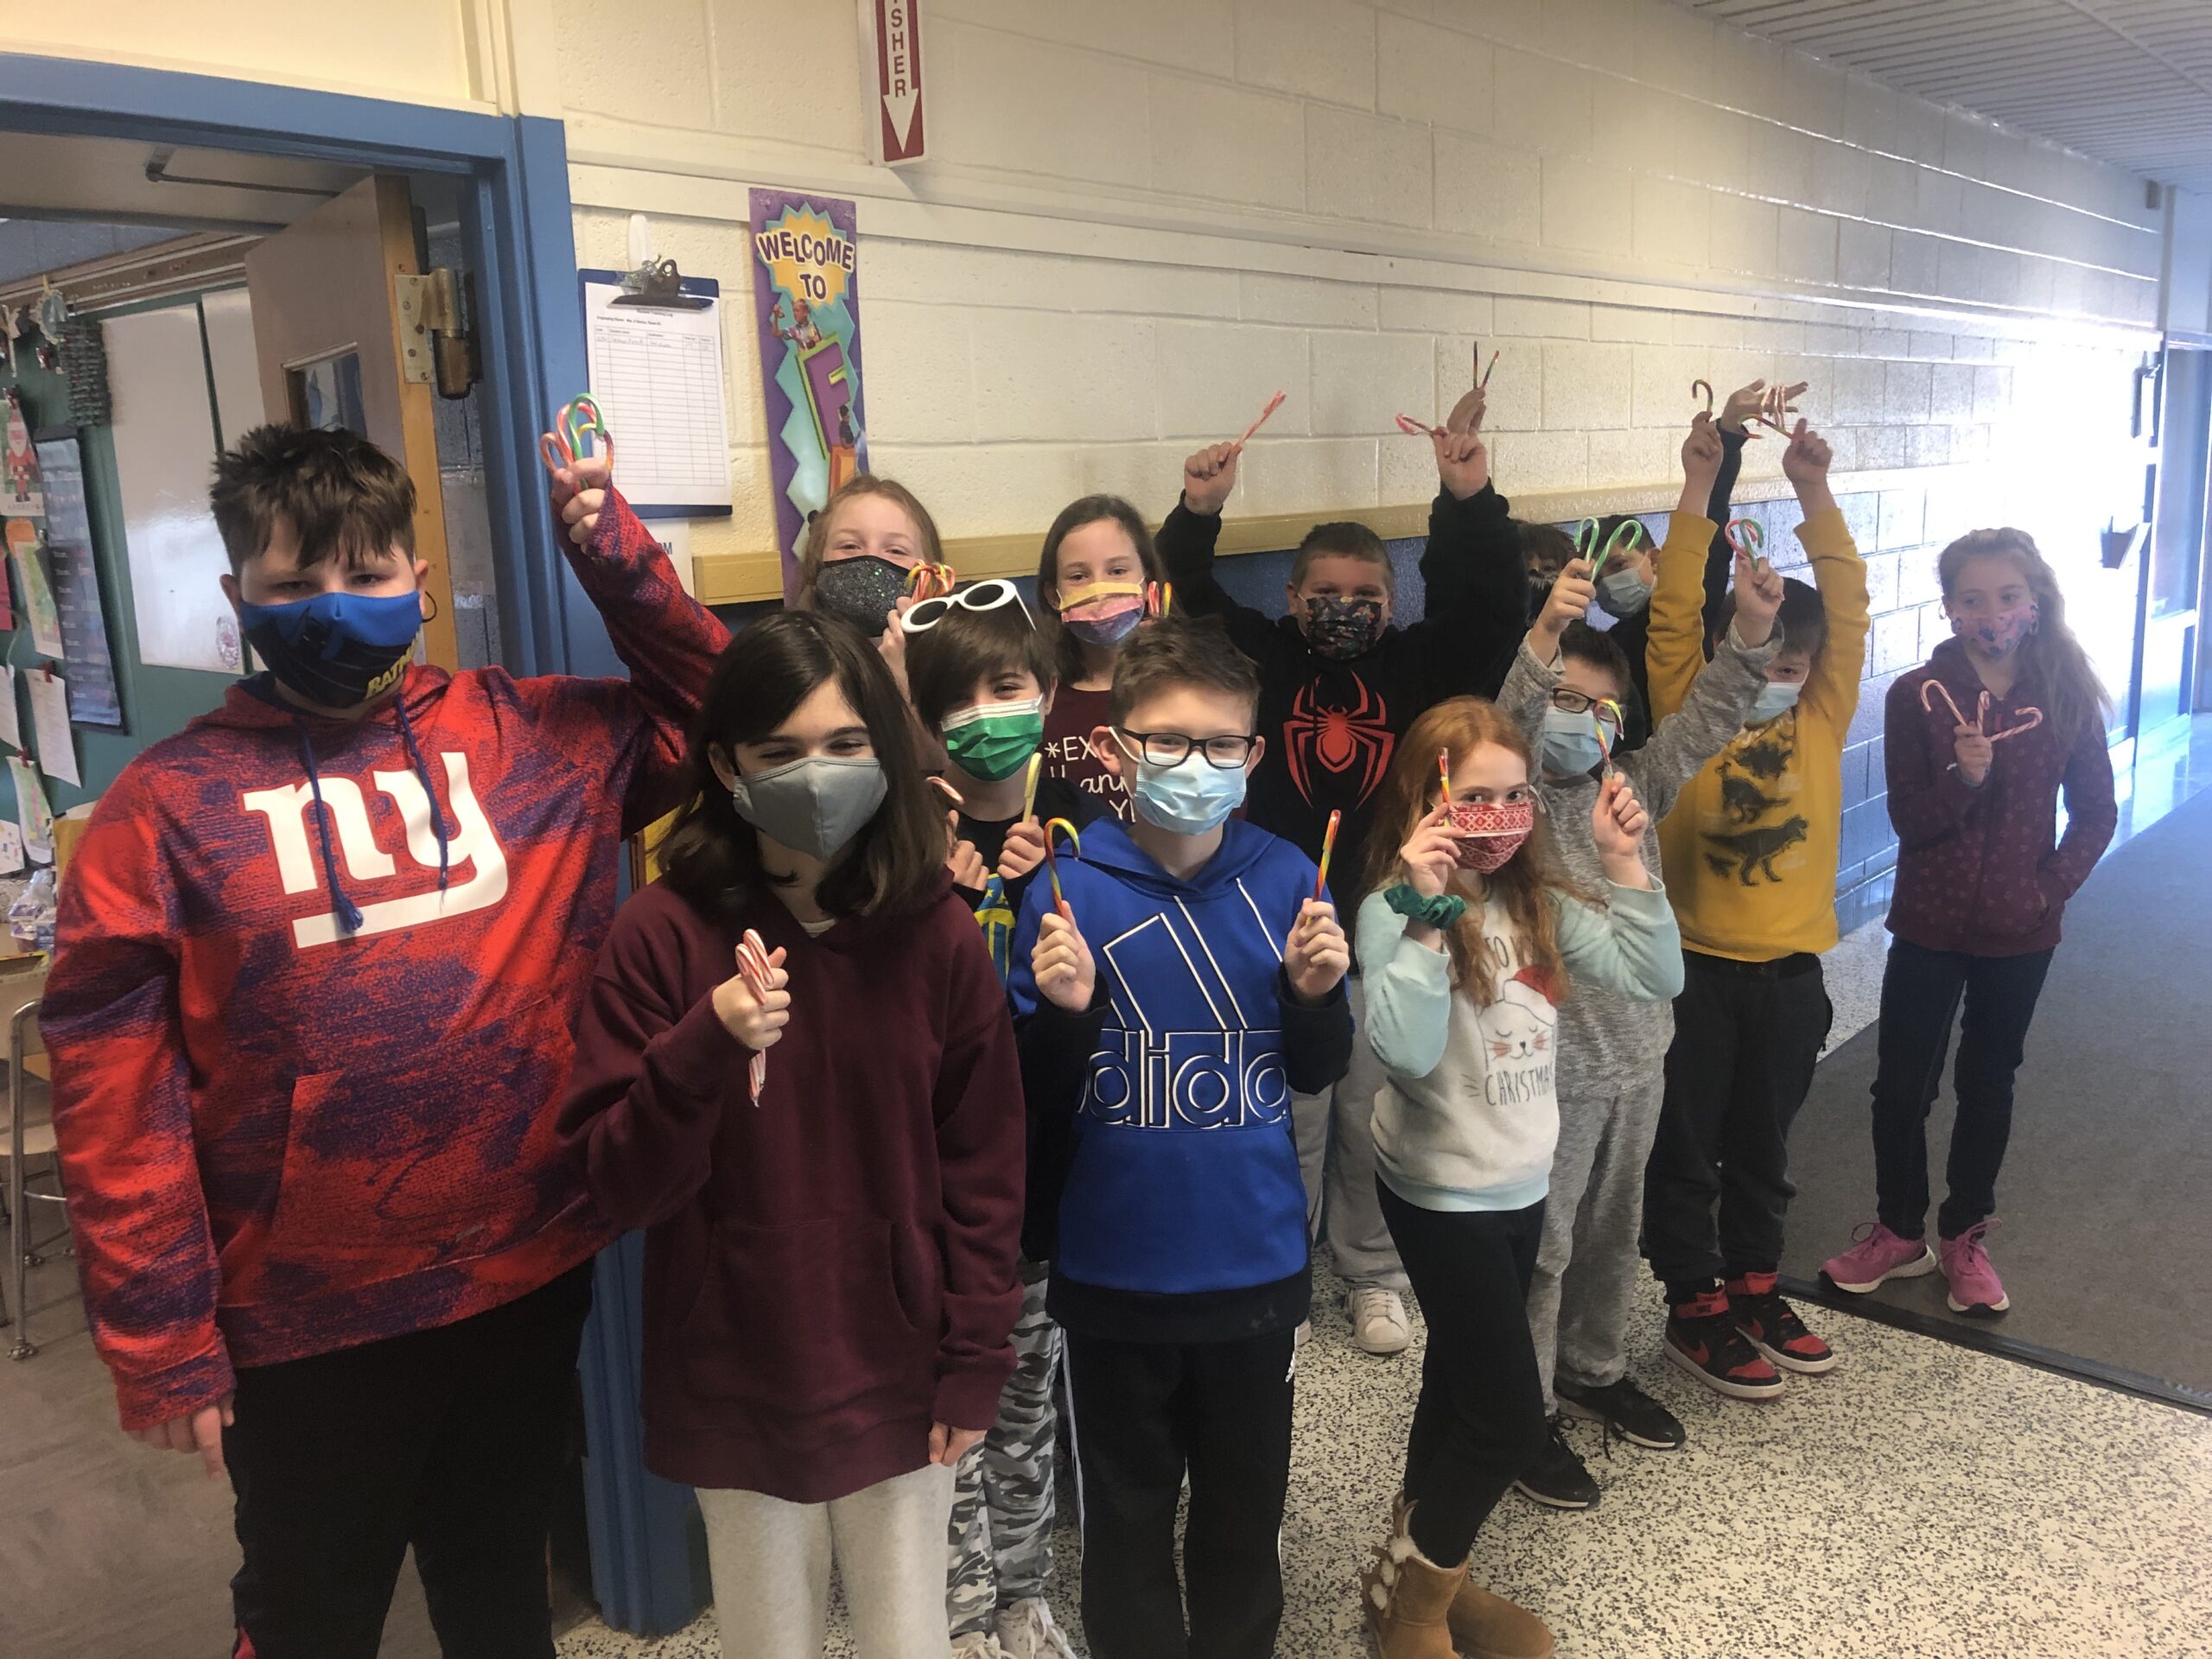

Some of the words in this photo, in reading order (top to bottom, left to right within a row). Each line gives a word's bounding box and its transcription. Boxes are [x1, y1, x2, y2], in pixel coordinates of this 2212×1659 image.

[891, 0, 906, 98] SHER
[758, 231, 854, 270] WELCOME
[799, 273, 827, 300] TO
